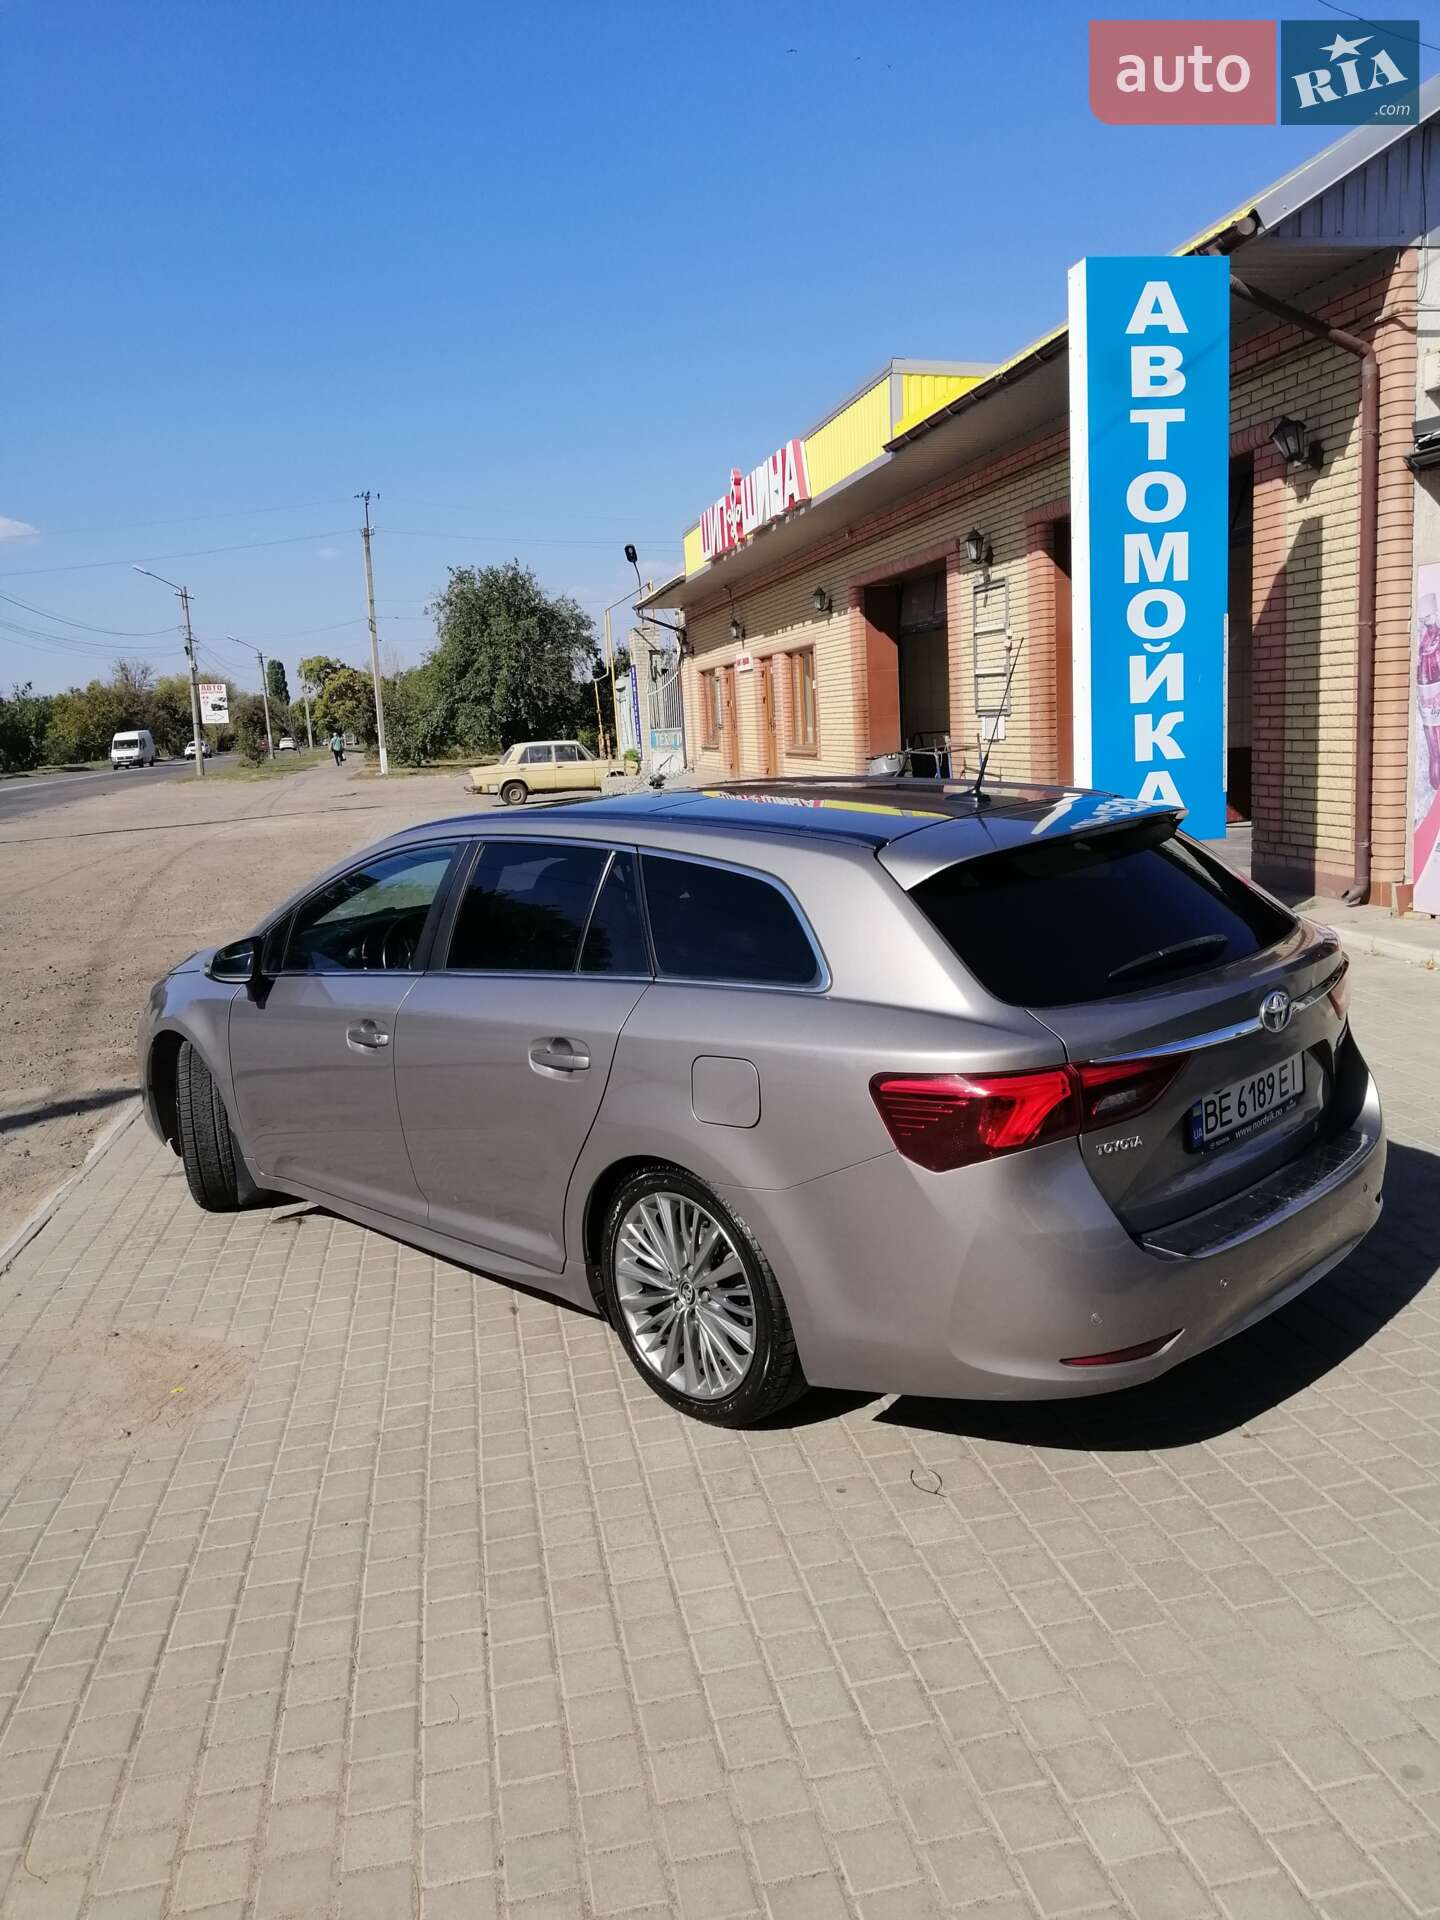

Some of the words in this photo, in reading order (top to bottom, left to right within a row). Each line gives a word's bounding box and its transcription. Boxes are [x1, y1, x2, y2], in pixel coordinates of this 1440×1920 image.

[1124, 280, 1190, 809] АВТОМОЙКА
[1204, 1092, 1232, 1134] BE
[1238, 1071, 1275, 1118] 6189
[1279, 1059, 1296, 1097] EI
[1095, 1135, 1143, 1156] TOYOTA
